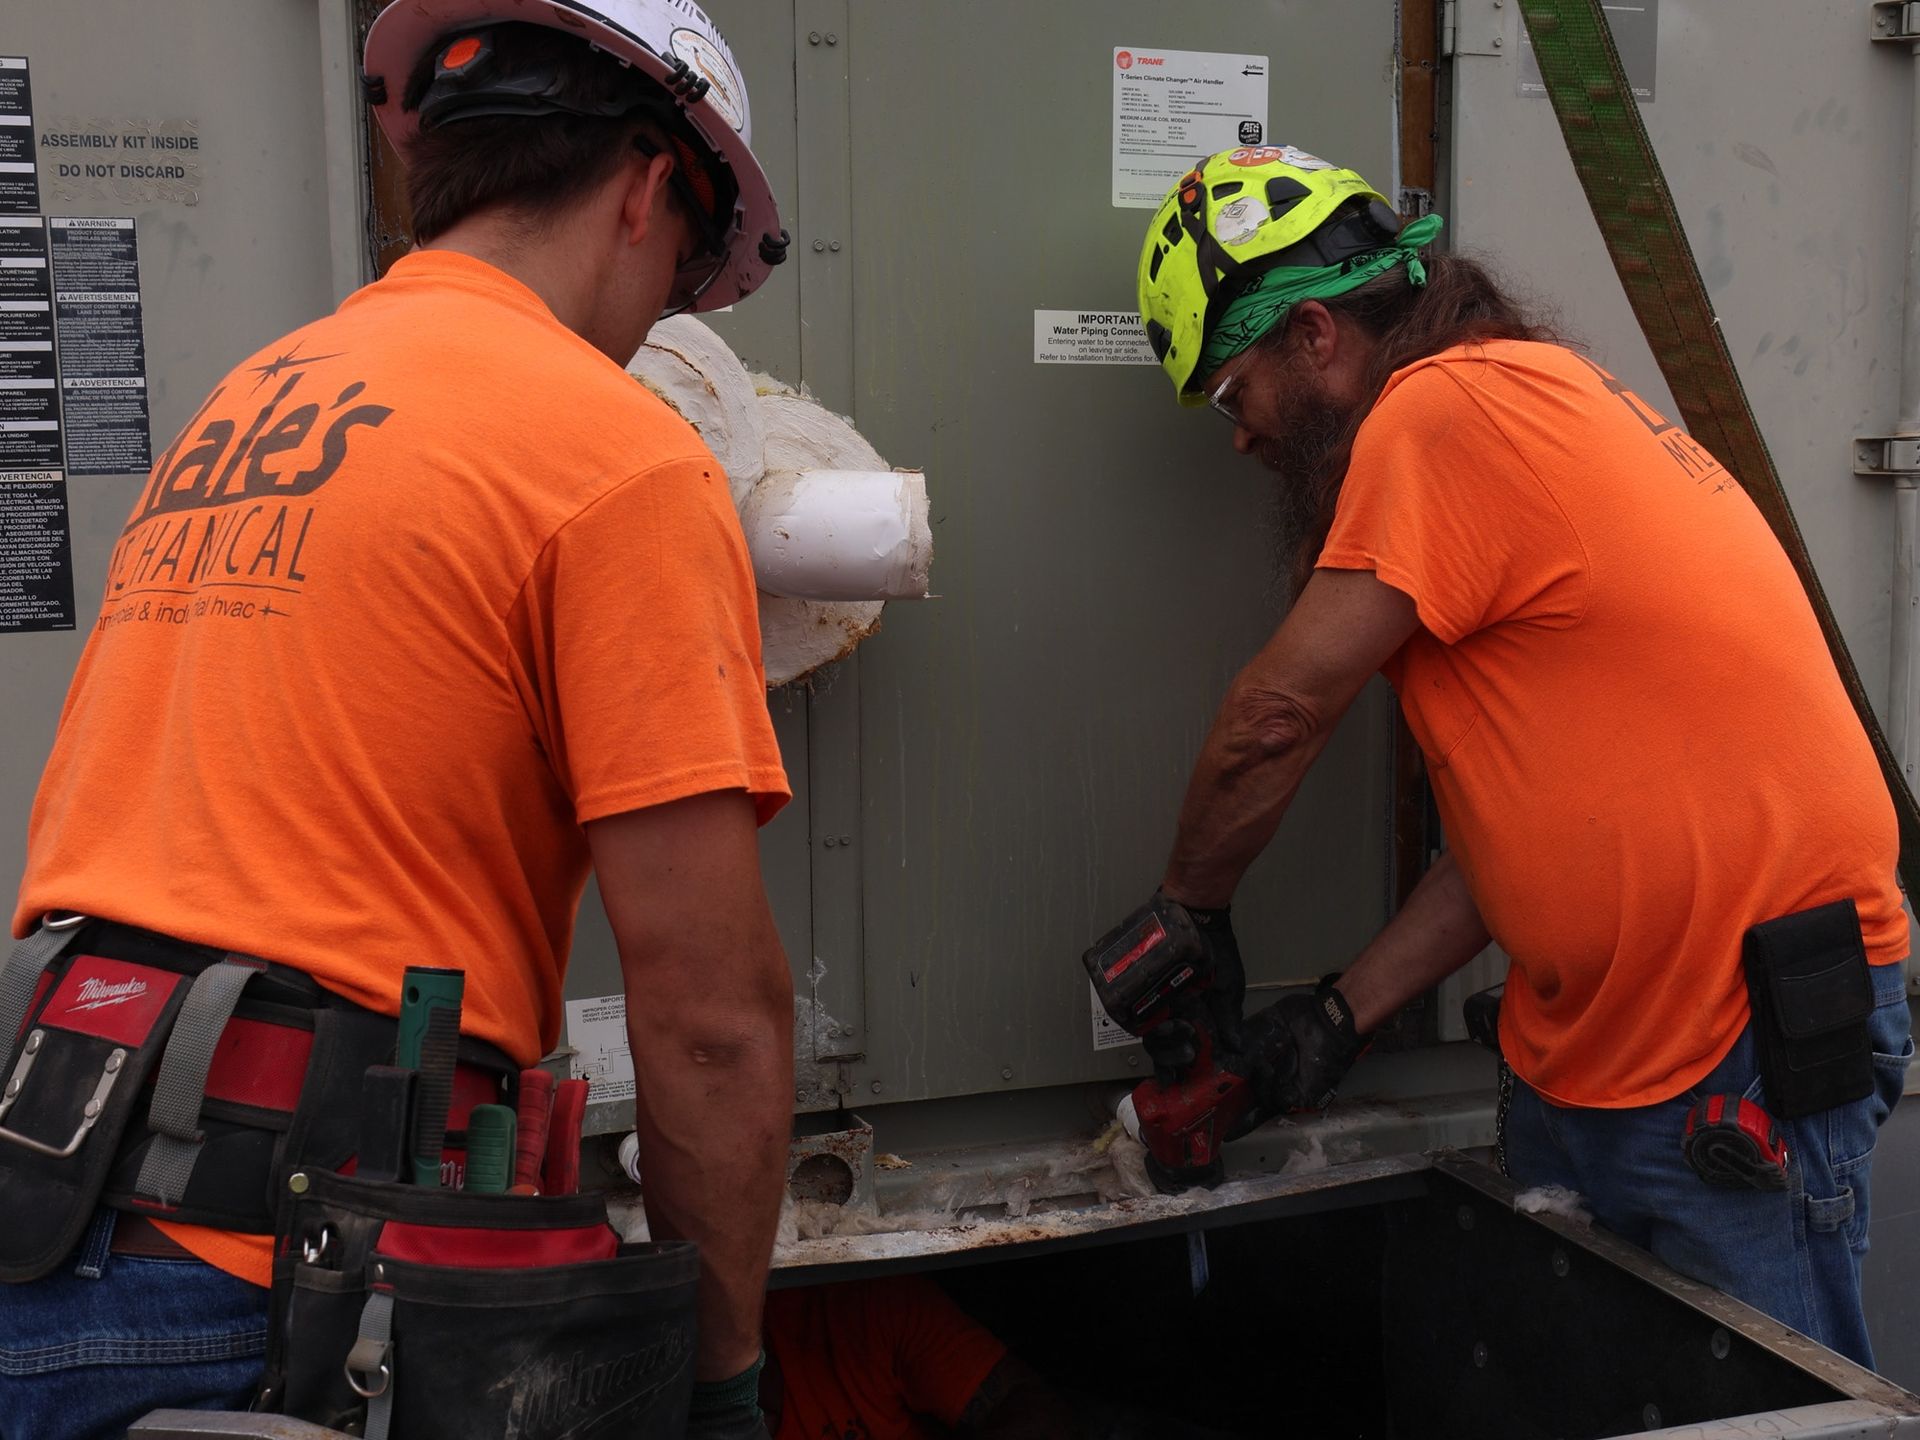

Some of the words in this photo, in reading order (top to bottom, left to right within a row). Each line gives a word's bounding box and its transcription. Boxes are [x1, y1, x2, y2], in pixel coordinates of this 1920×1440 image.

[1136, 57, 1165, 65] TRANE
[41, 134, 117, 148] ASSEMBLY
[123, 136, 146, 148] KIT
[151, 136, 199, 149] INSIDE
[60, 165, 80, 177] DO
[86, 165, 115, 177] NOT
[120, 165, 185, 178] DISCARD
[1078, 315, 1141, 325] IMPORTANT
[1053, 327, 1078, 336] Water
[1081, 327, 1108, 337] Piping
[1048, 338, 1076, 346] Entering
[1106, 338, 1114, 346] be
[1115, 338, 1149, 346] connected
[138, 601, 151, 622] &
[210, 595, 256, 619] hvac
[77, 977, 147, 1002] Milwaukee
